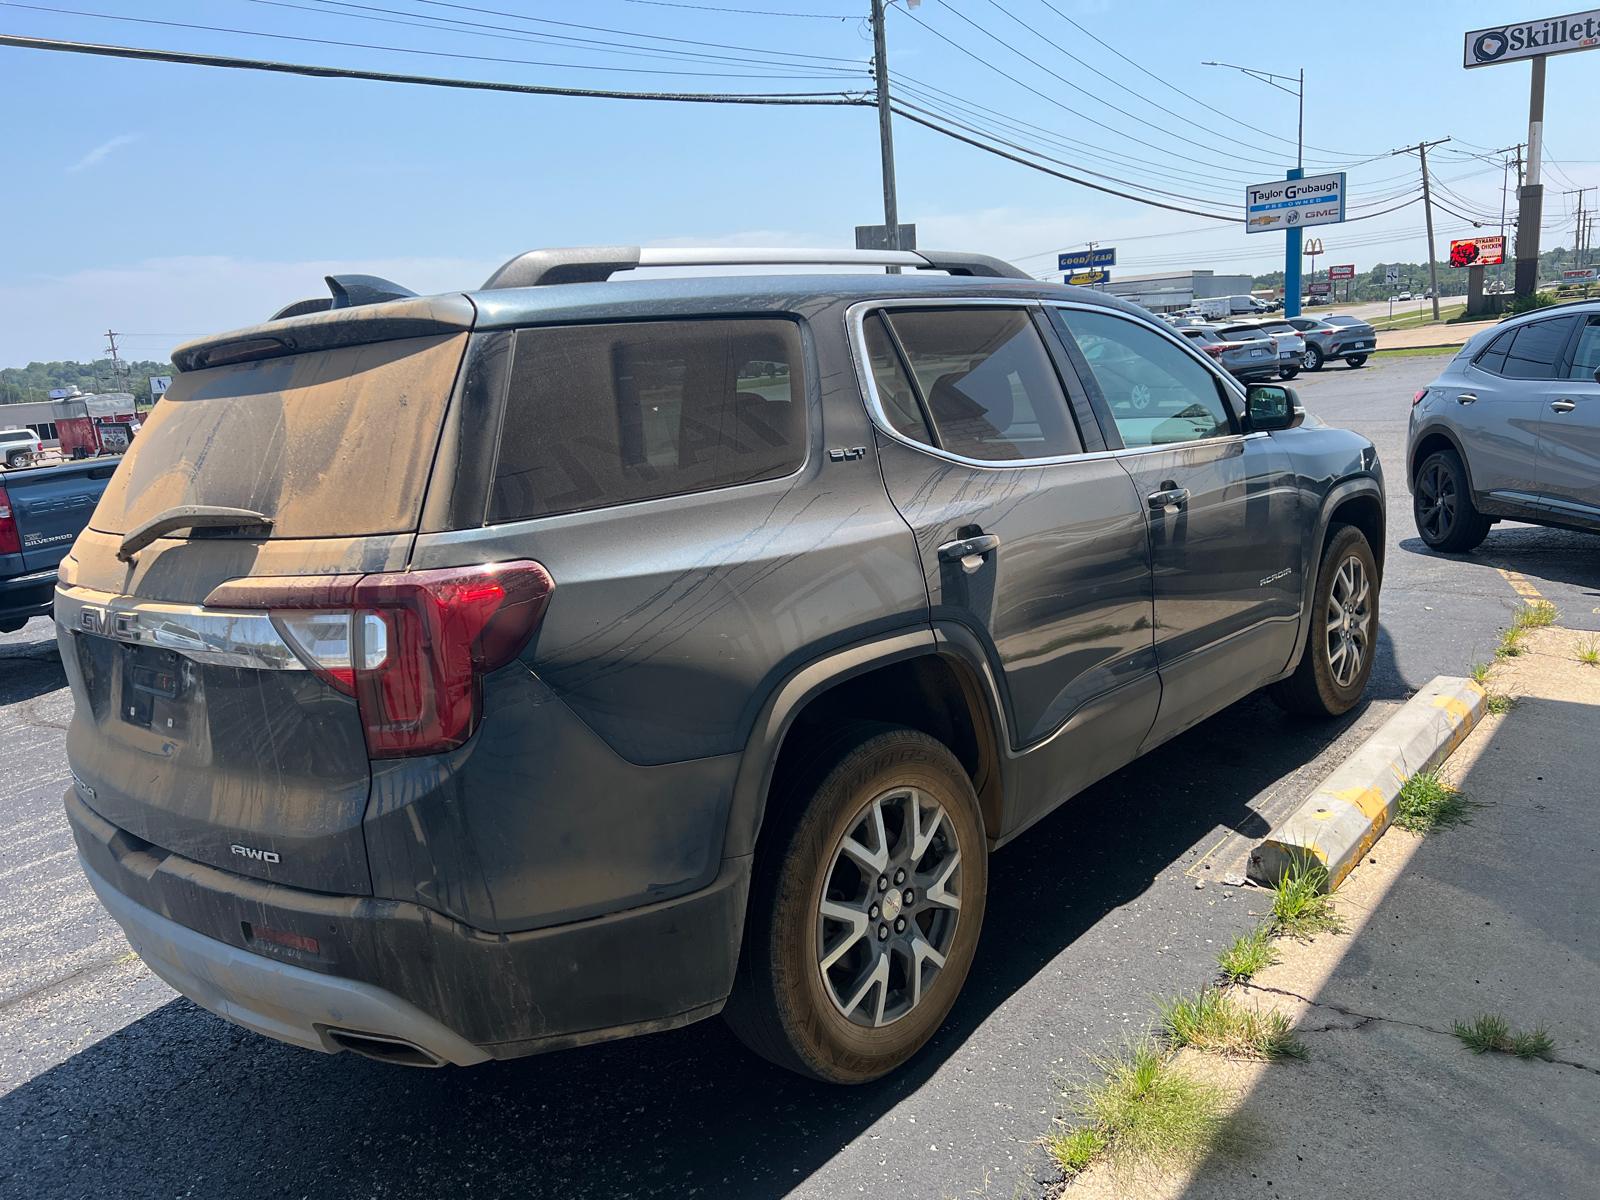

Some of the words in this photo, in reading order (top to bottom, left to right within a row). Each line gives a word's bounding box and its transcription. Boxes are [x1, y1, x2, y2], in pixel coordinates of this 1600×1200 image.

[1250, 190, 1283, 204] Taylor
[1285, 181, 1338, 199] Grubaugh
[1265, 198, 1321, 209] PRE-OWNED
[1305, 208, 1339, 219] GMC
[829, 446, 867, 459] SLT
[25, 533, 73, 547] SILVERADO
[1259, 567, 1292, 587] ACADIA
[80, 605, 139, 637] GMC
[230, 844, 280, 864] AWD
[885, 896, 900, 914] GMC
